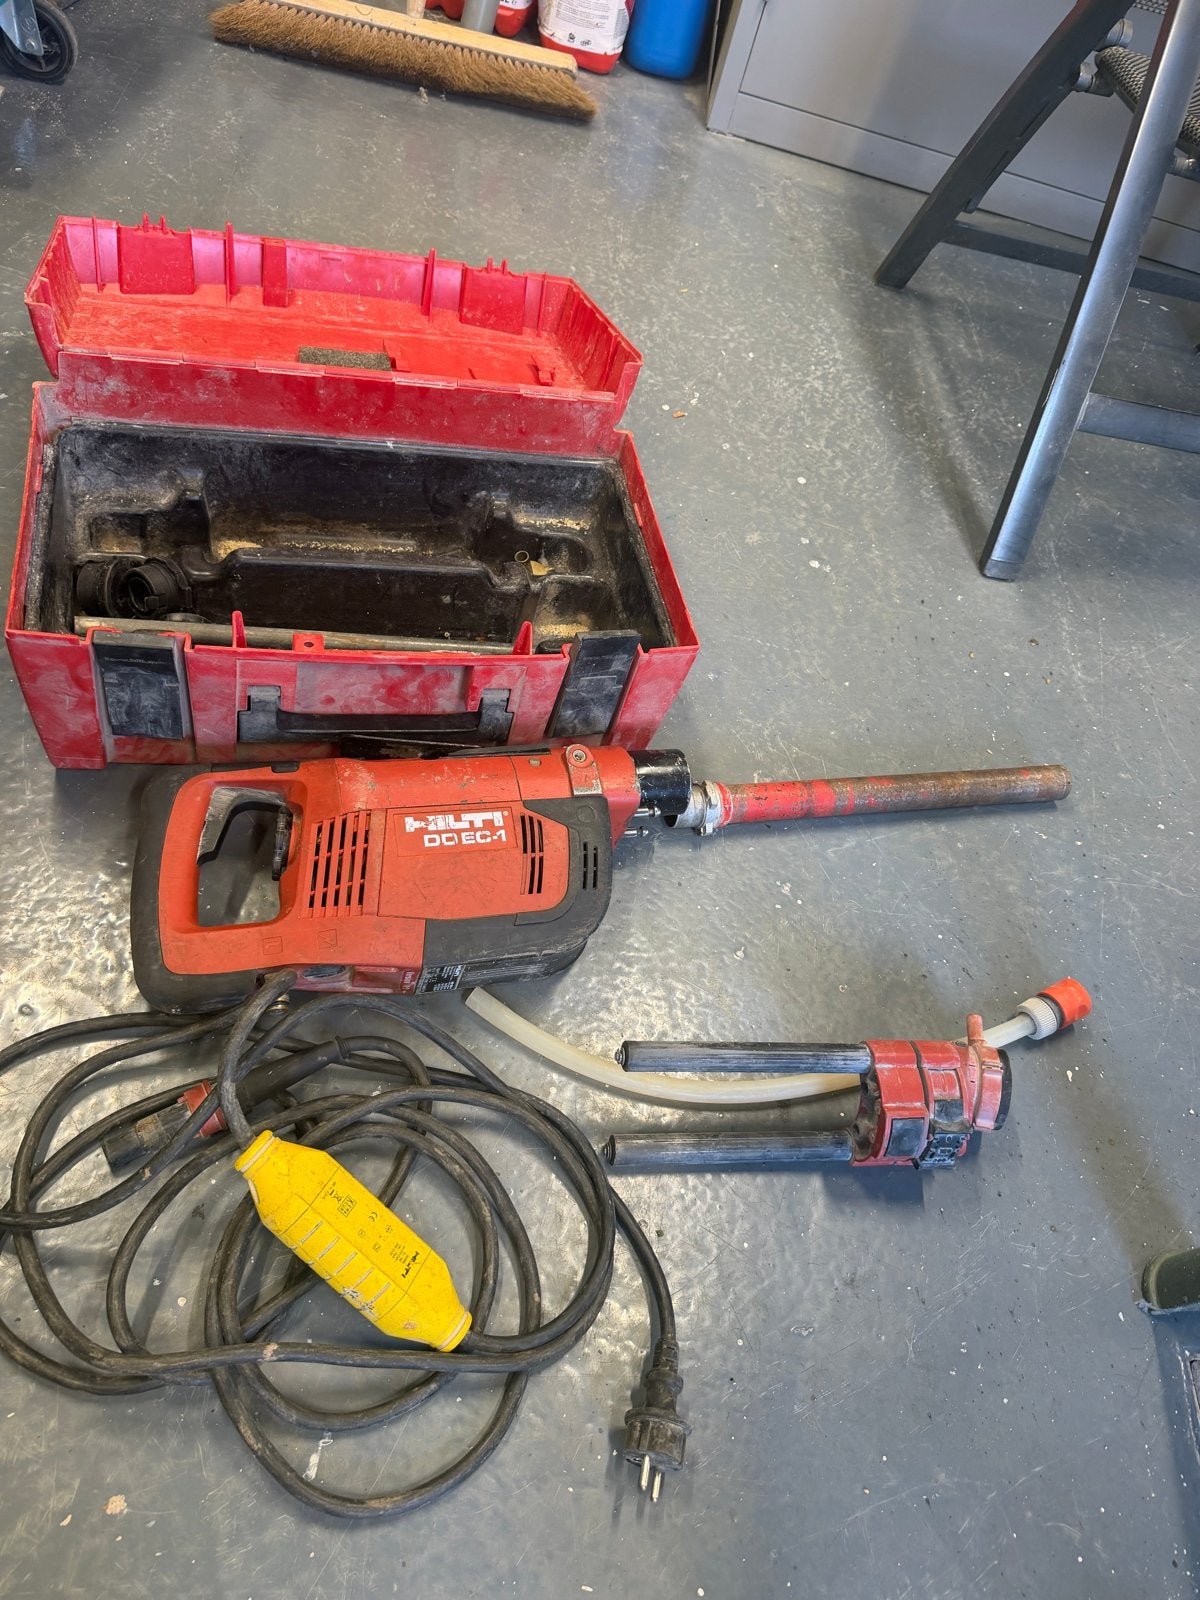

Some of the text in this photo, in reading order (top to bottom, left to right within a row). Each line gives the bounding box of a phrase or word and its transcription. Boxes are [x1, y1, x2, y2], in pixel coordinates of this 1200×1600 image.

[405, 811, 504, 832] HILTI
[423, 829, 507, 847] DD EC-1
